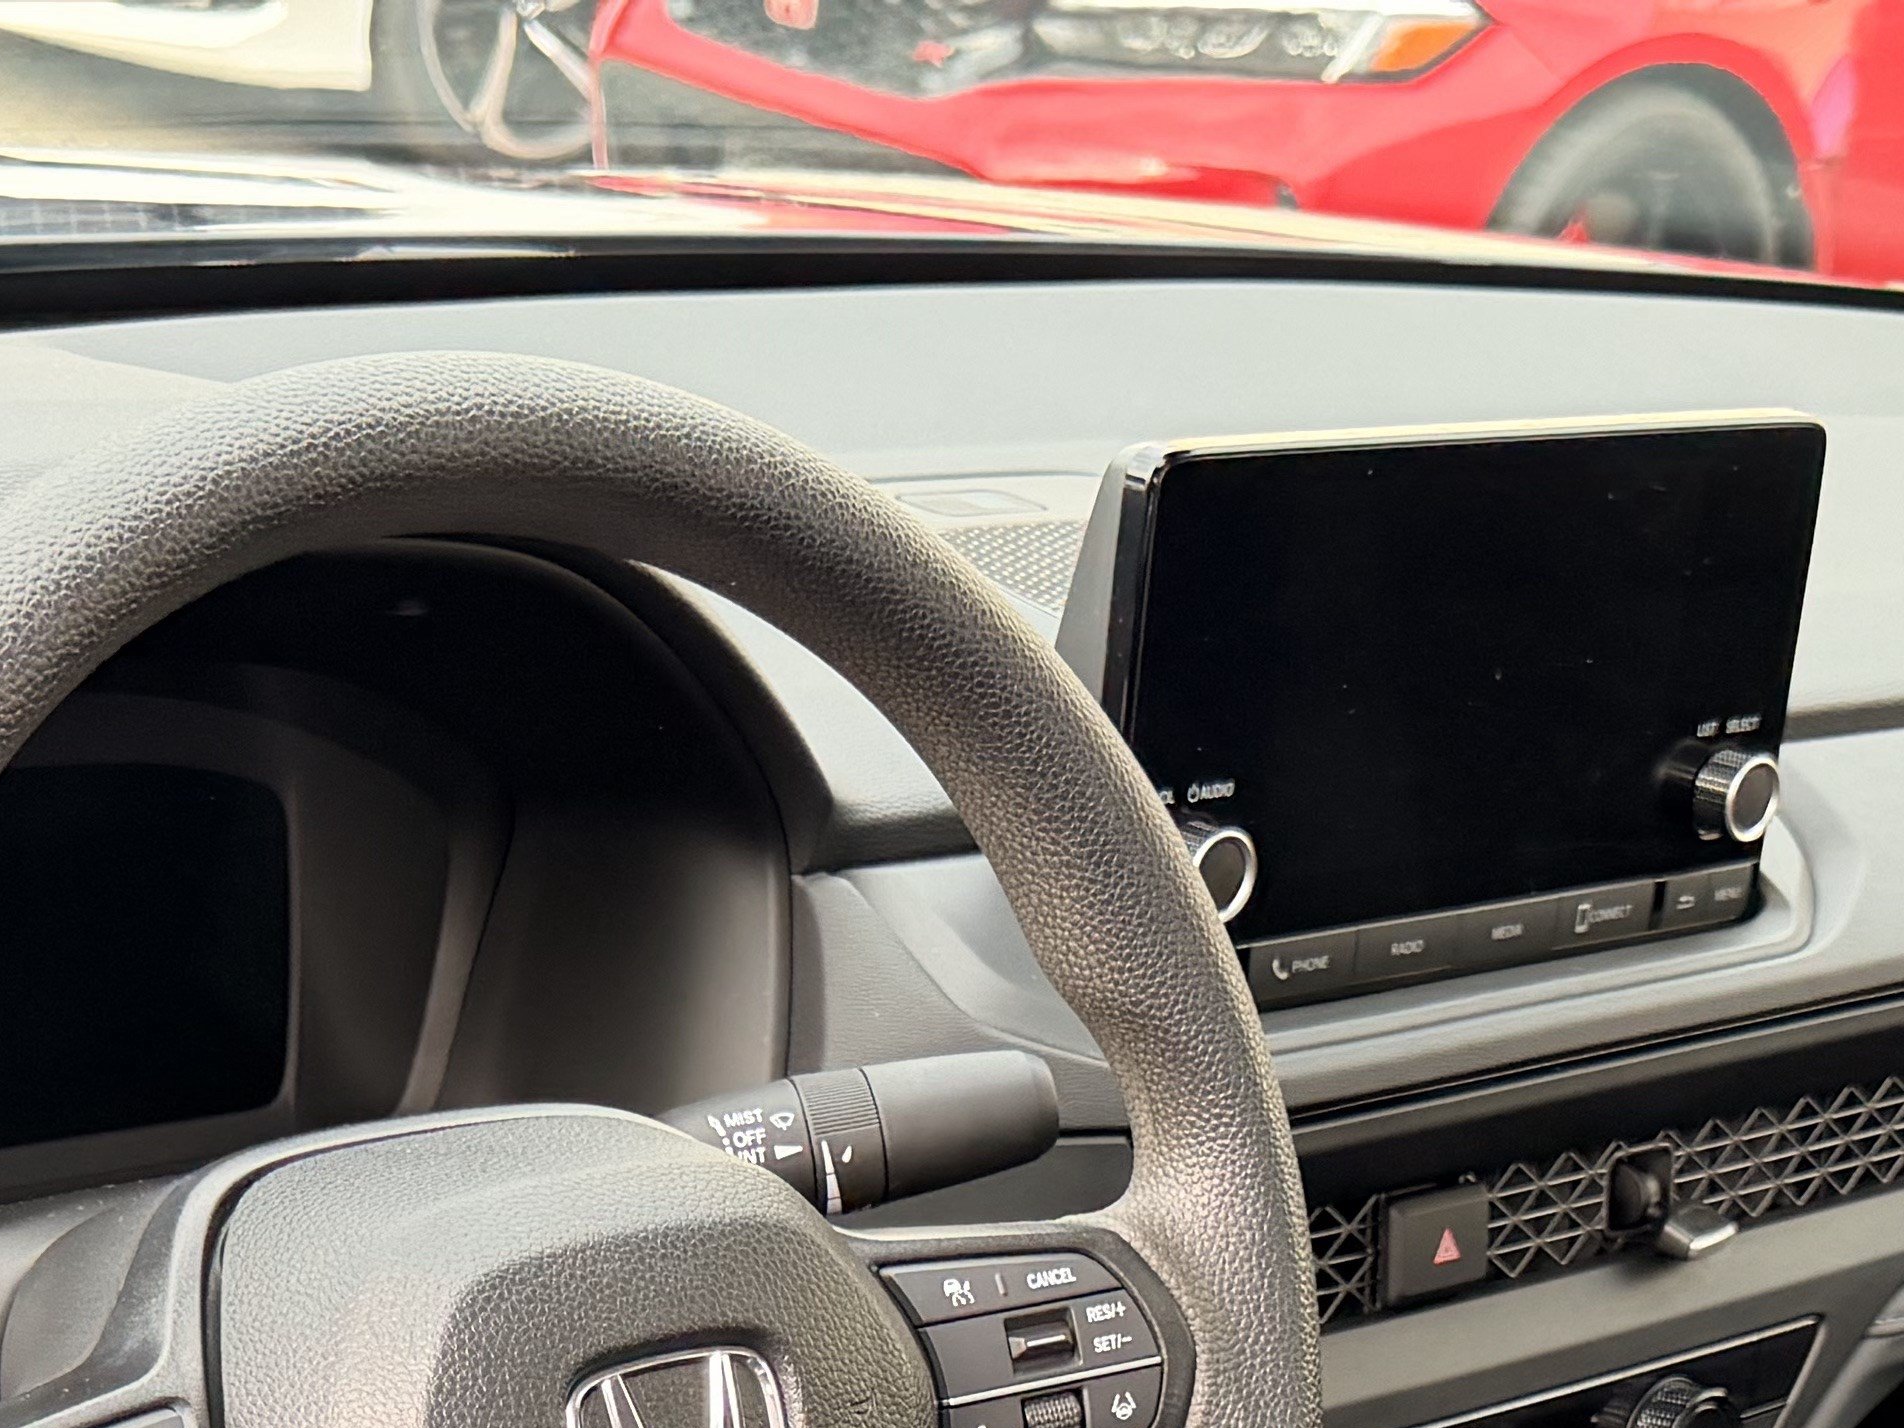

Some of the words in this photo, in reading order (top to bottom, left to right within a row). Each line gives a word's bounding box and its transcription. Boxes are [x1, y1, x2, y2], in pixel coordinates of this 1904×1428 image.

[1158, 789, 1176, 805] OL
[1391, 939, 1426, 956] RADIO
[1291, 955, 1331, 974] PHONE
[723, 1108, 763, 1127] MIST
[733, 1127, 767, 1148] OFF
[1026, 1267, 1077, 1290] CANCEL
[1086, 1301, 1127, 1323] RES/+
